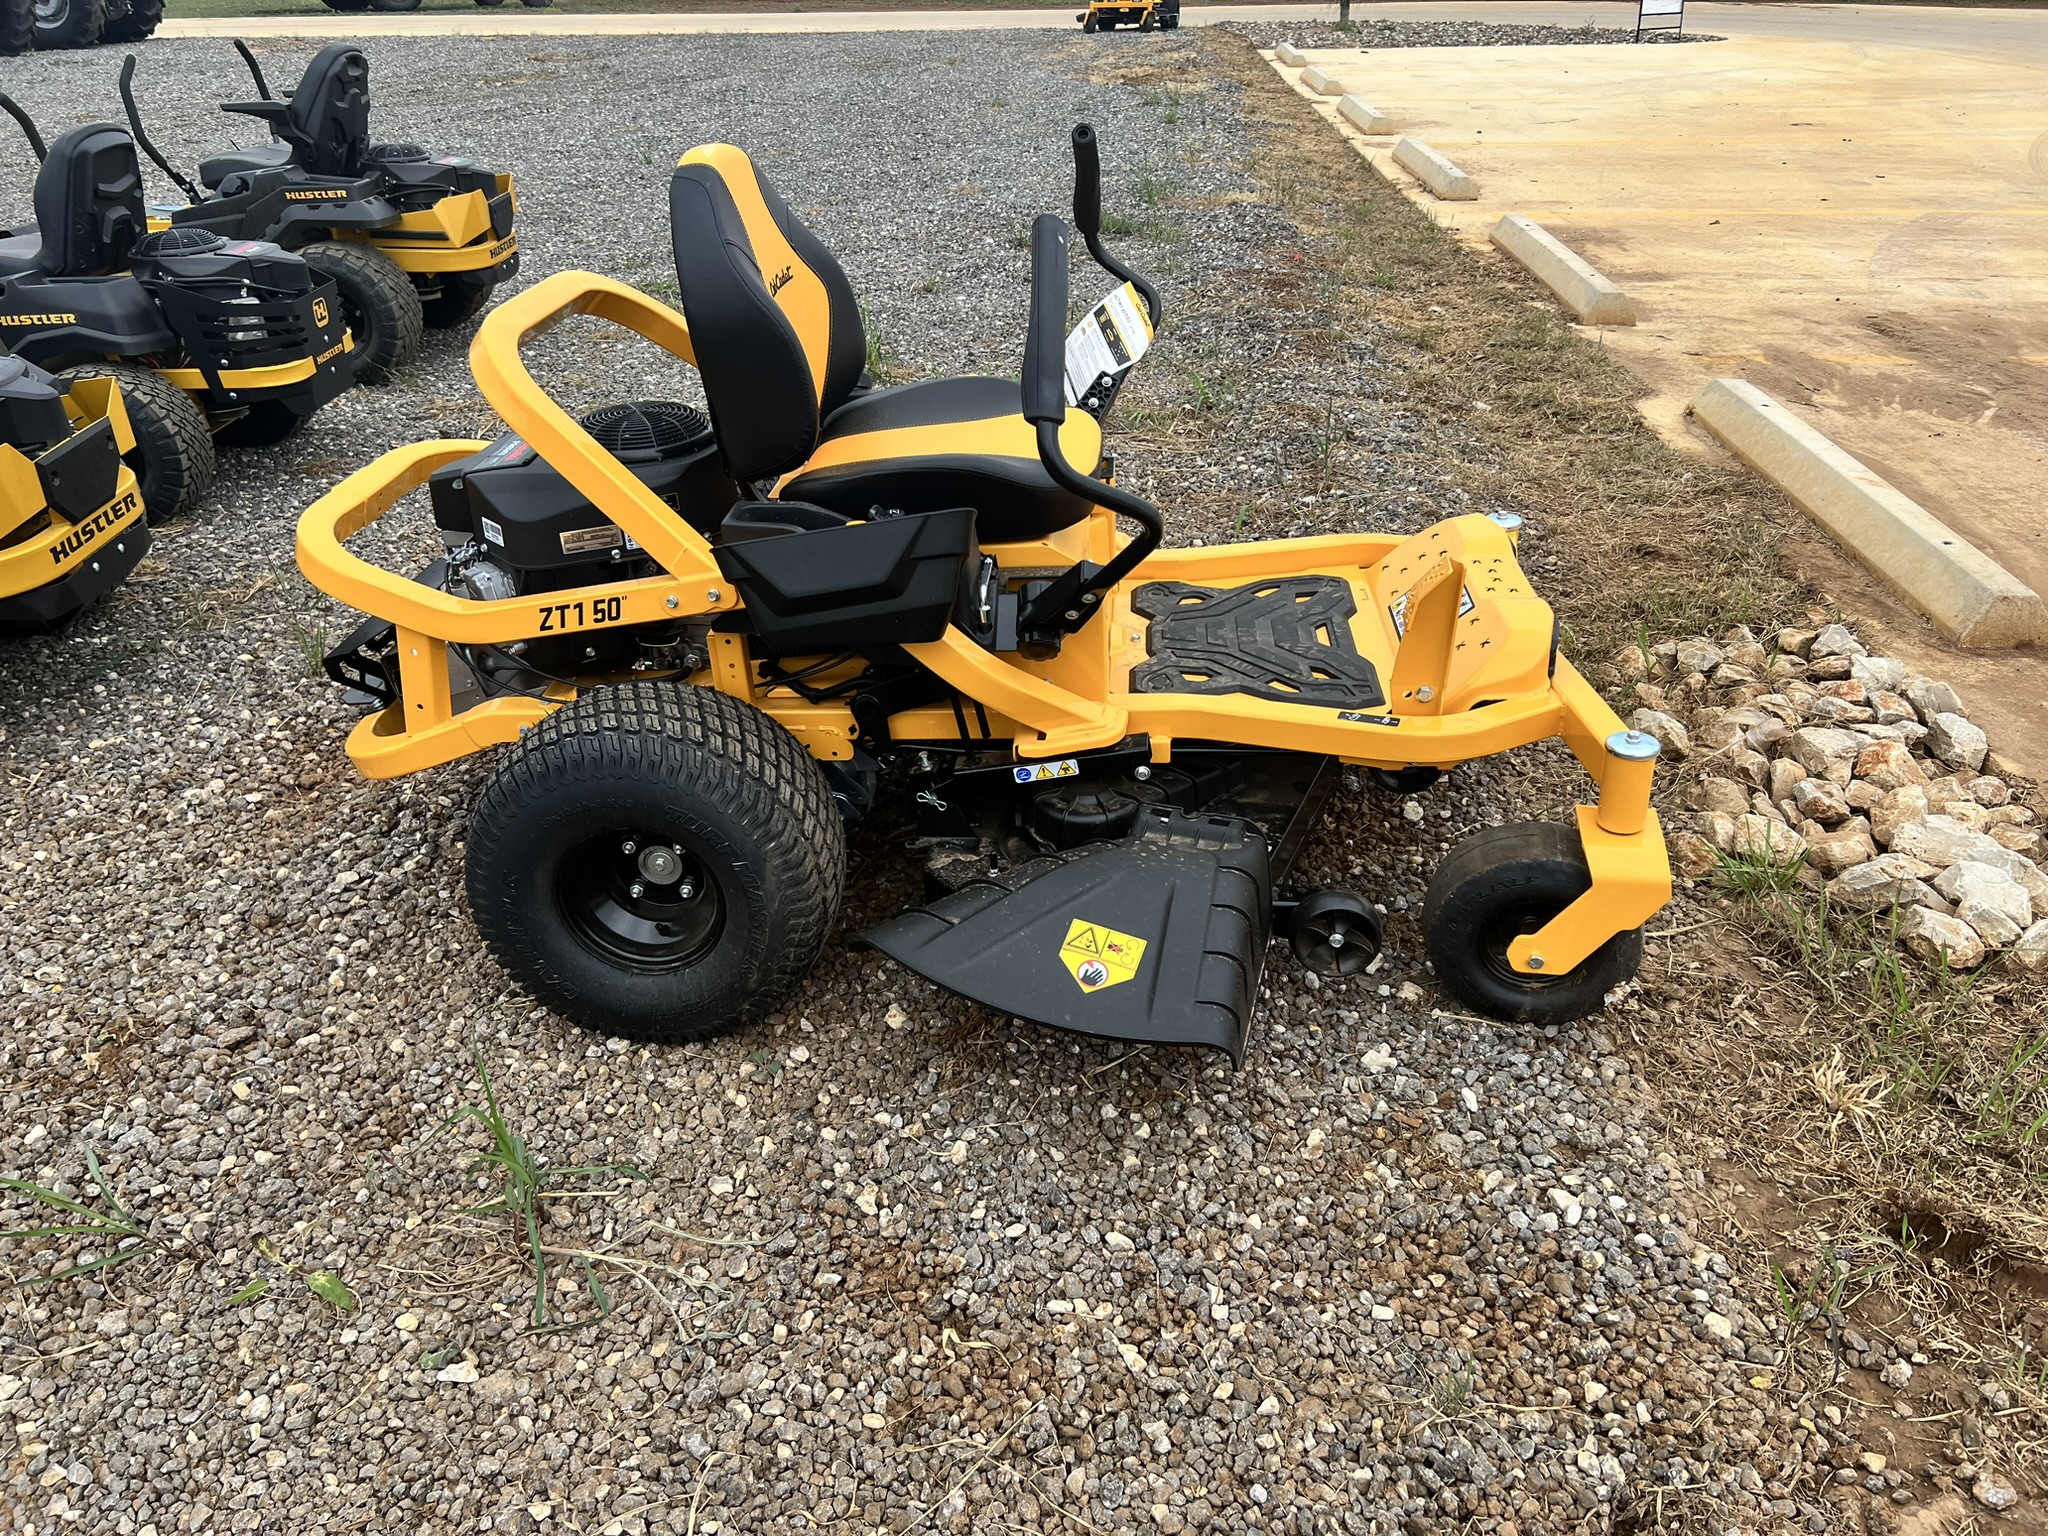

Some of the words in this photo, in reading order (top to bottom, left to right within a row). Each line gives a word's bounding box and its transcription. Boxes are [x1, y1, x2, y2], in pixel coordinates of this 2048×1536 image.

[285, 189, 348, 200] HUSTLER
[490, 236, 517, 260] HUSTLER
[317, 342, 344, 365] HUSTLER
[49, 492, 137, 565] HUSTLER
[539, 602, 584, 632] ZT1
[593, 595, 627, 624] 50"
[664, 804, 745, 857] TURF
[731, 860, 770, 978] MASTER
